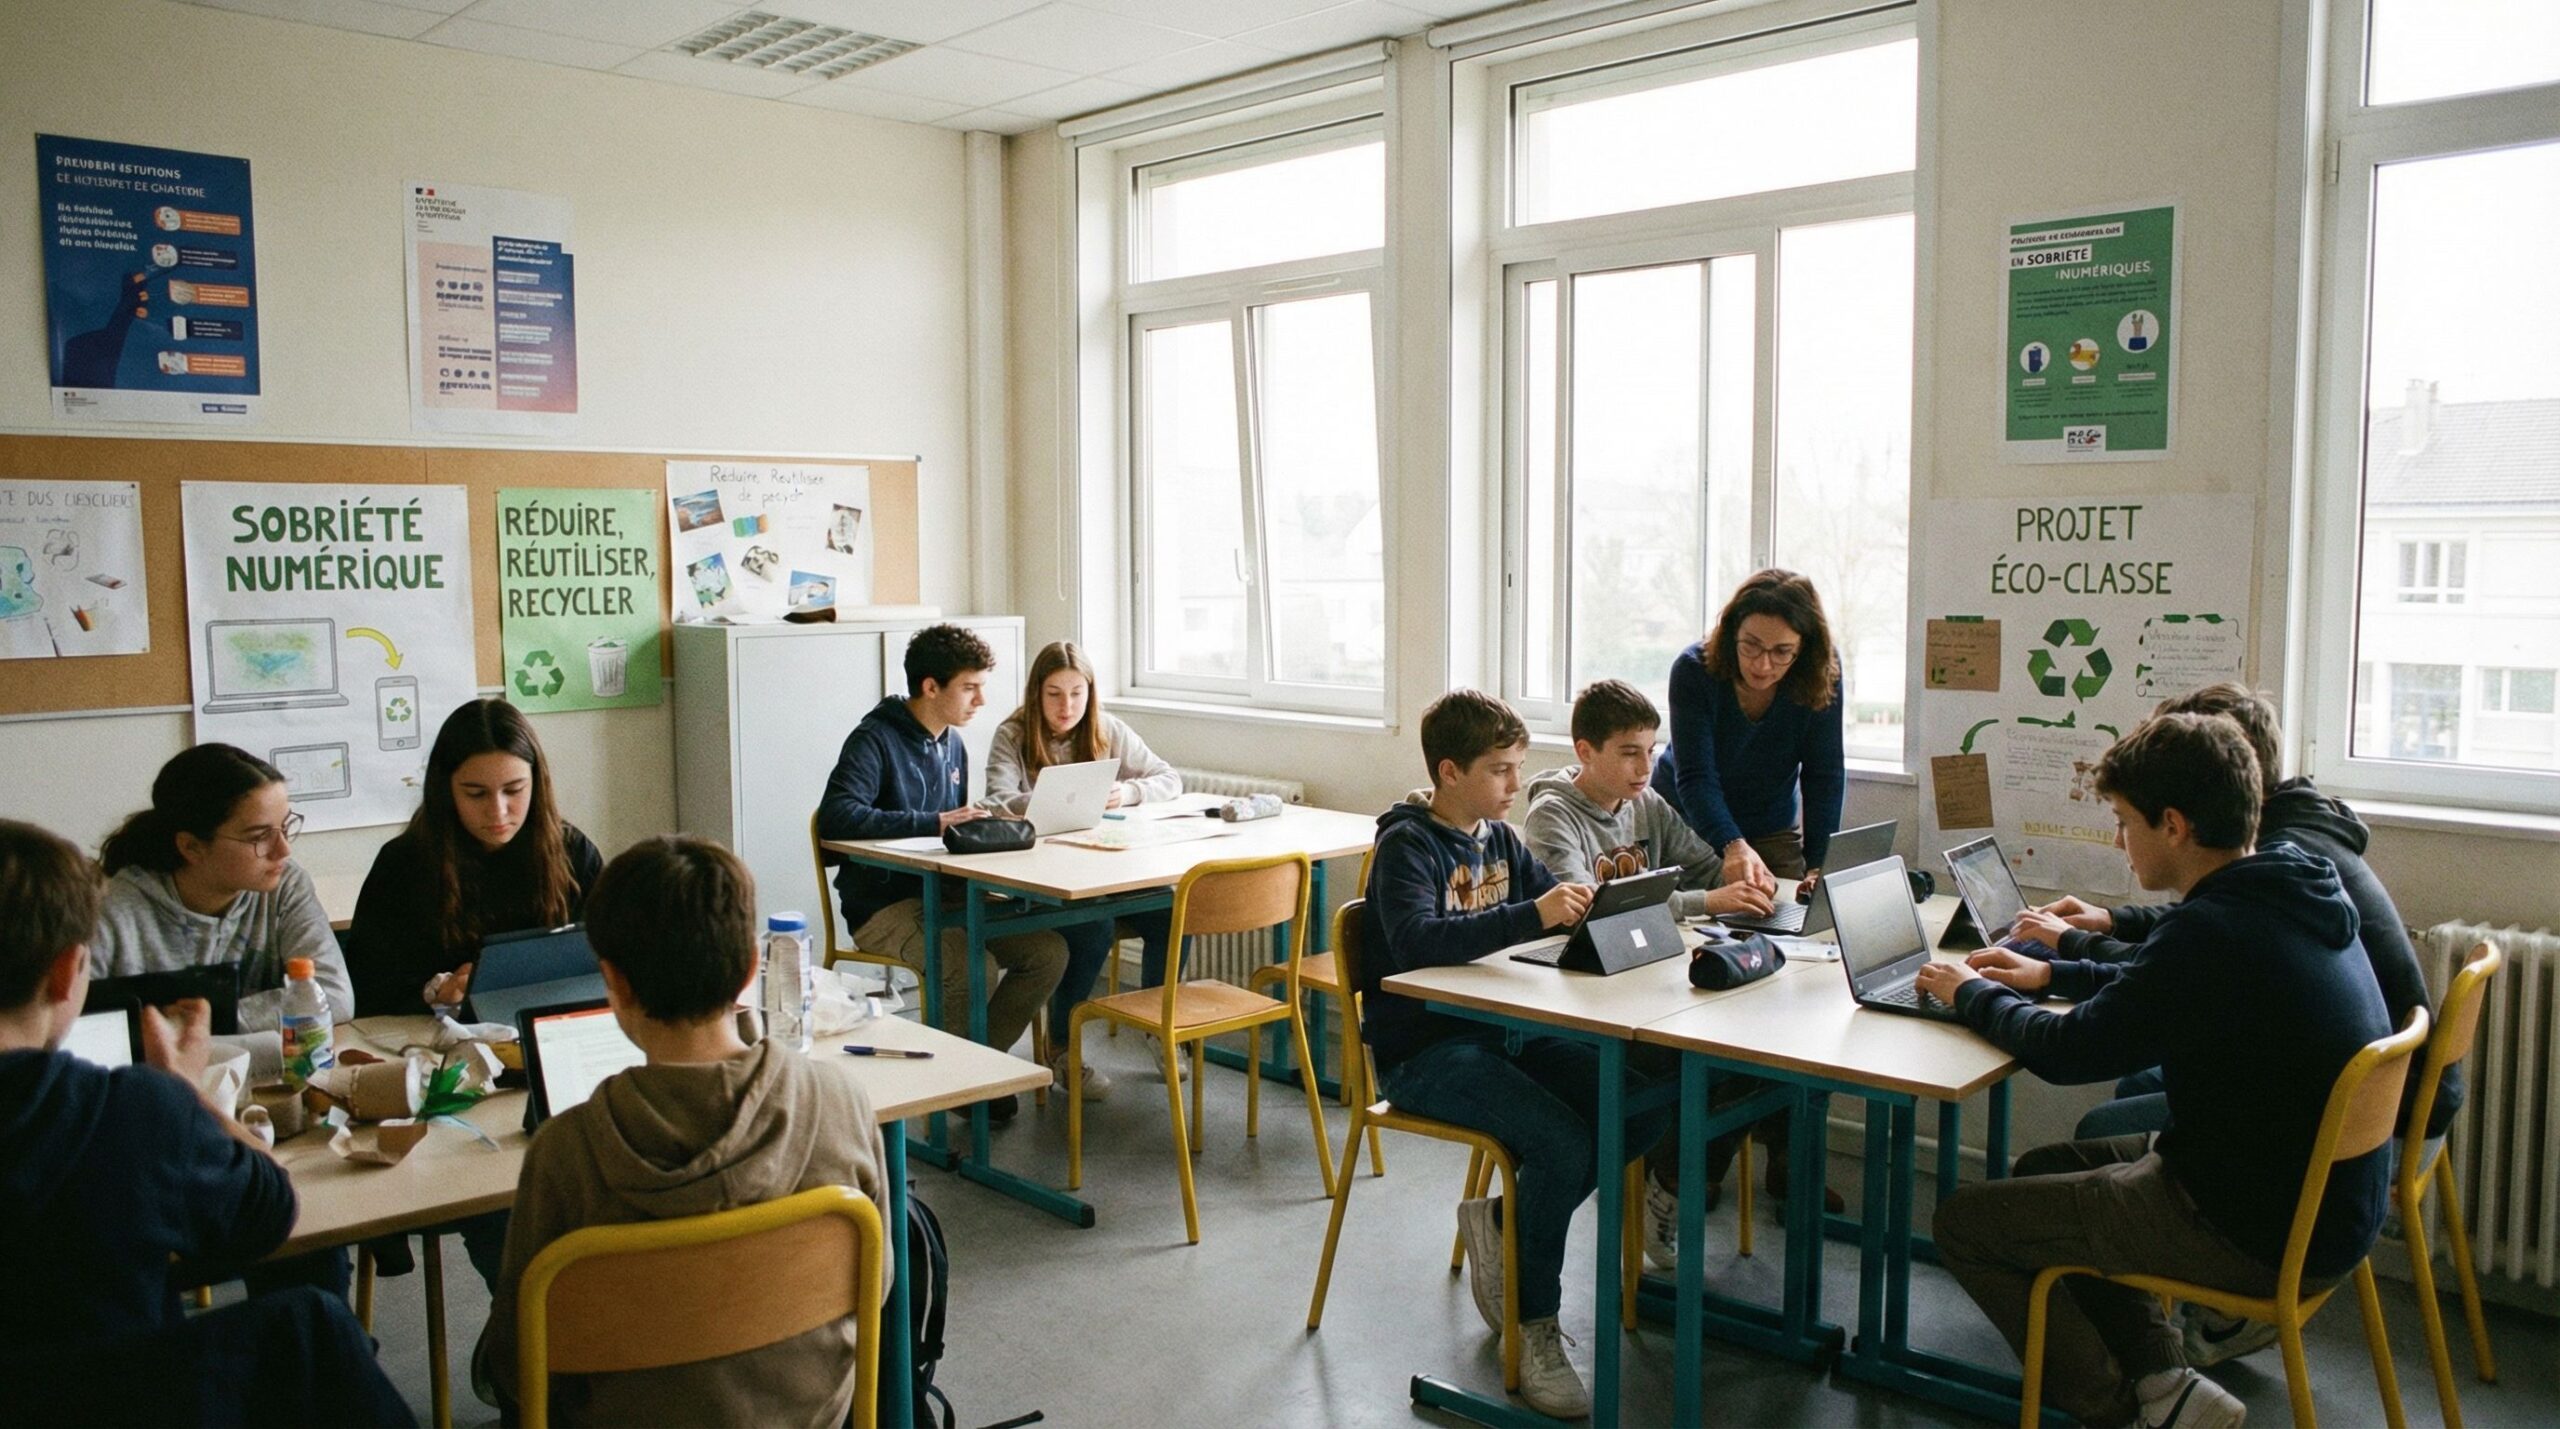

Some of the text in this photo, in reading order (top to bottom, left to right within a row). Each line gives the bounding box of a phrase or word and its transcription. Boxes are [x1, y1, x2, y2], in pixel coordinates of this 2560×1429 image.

[232, 496, 424, 543] SOBRIÉTÉ
[505, 500, 624, 540] RÉDUIRE,
[2016, 505, 2143, 542] PROJET
[226, 545, 445, 592] NUMÉRIQUE
[507, 540, 656, 581] RÉUTILISER,
[1991, 553, 2173, 595] ÉCO-CLASSE
[508, 586, 635, 618] RECYCLER
